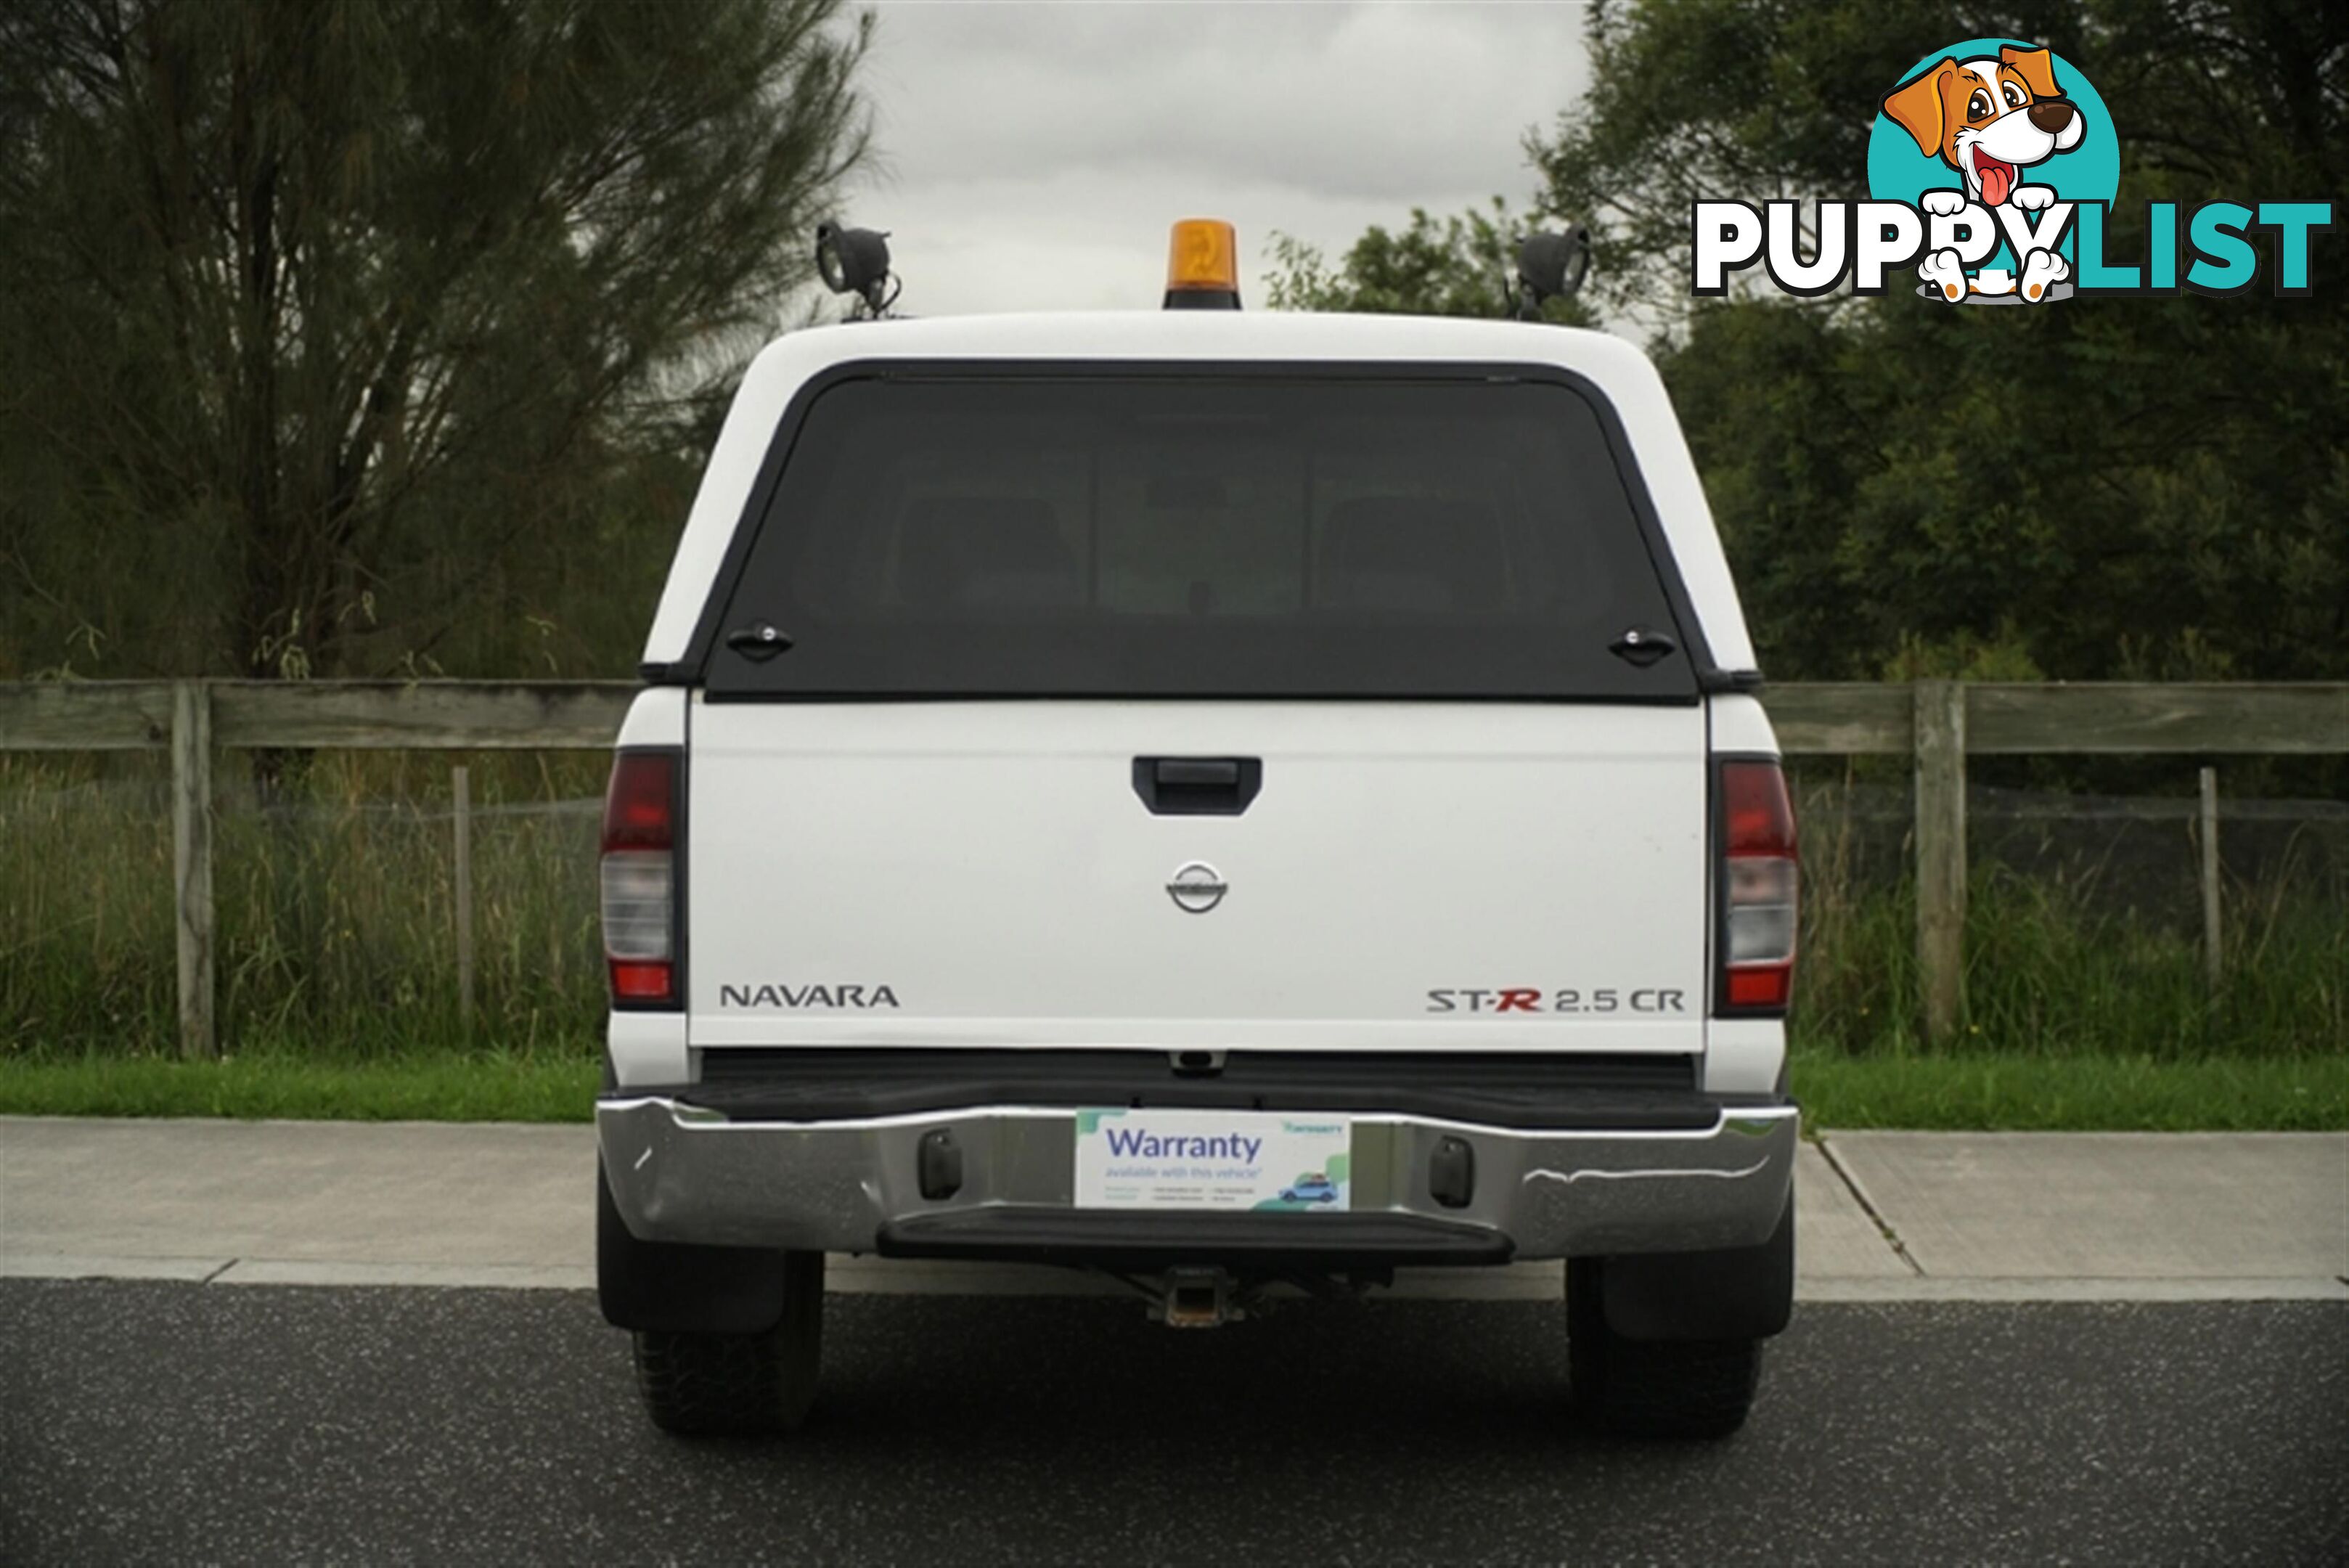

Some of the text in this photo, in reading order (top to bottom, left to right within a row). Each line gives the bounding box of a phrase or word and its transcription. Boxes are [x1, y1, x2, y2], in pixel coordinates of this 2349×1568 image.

[720, 984, 900, 1008] NAVARA
[1426, 988, 1684, 1012] ST-R 2.5 CR
[1106, 1128, 1262, 1164] Warranty
[1105, 1167, 1156, 1177] available
[1161, 1167, 1187, 1177] with
[1191, 1167, 1212, 1177] this
